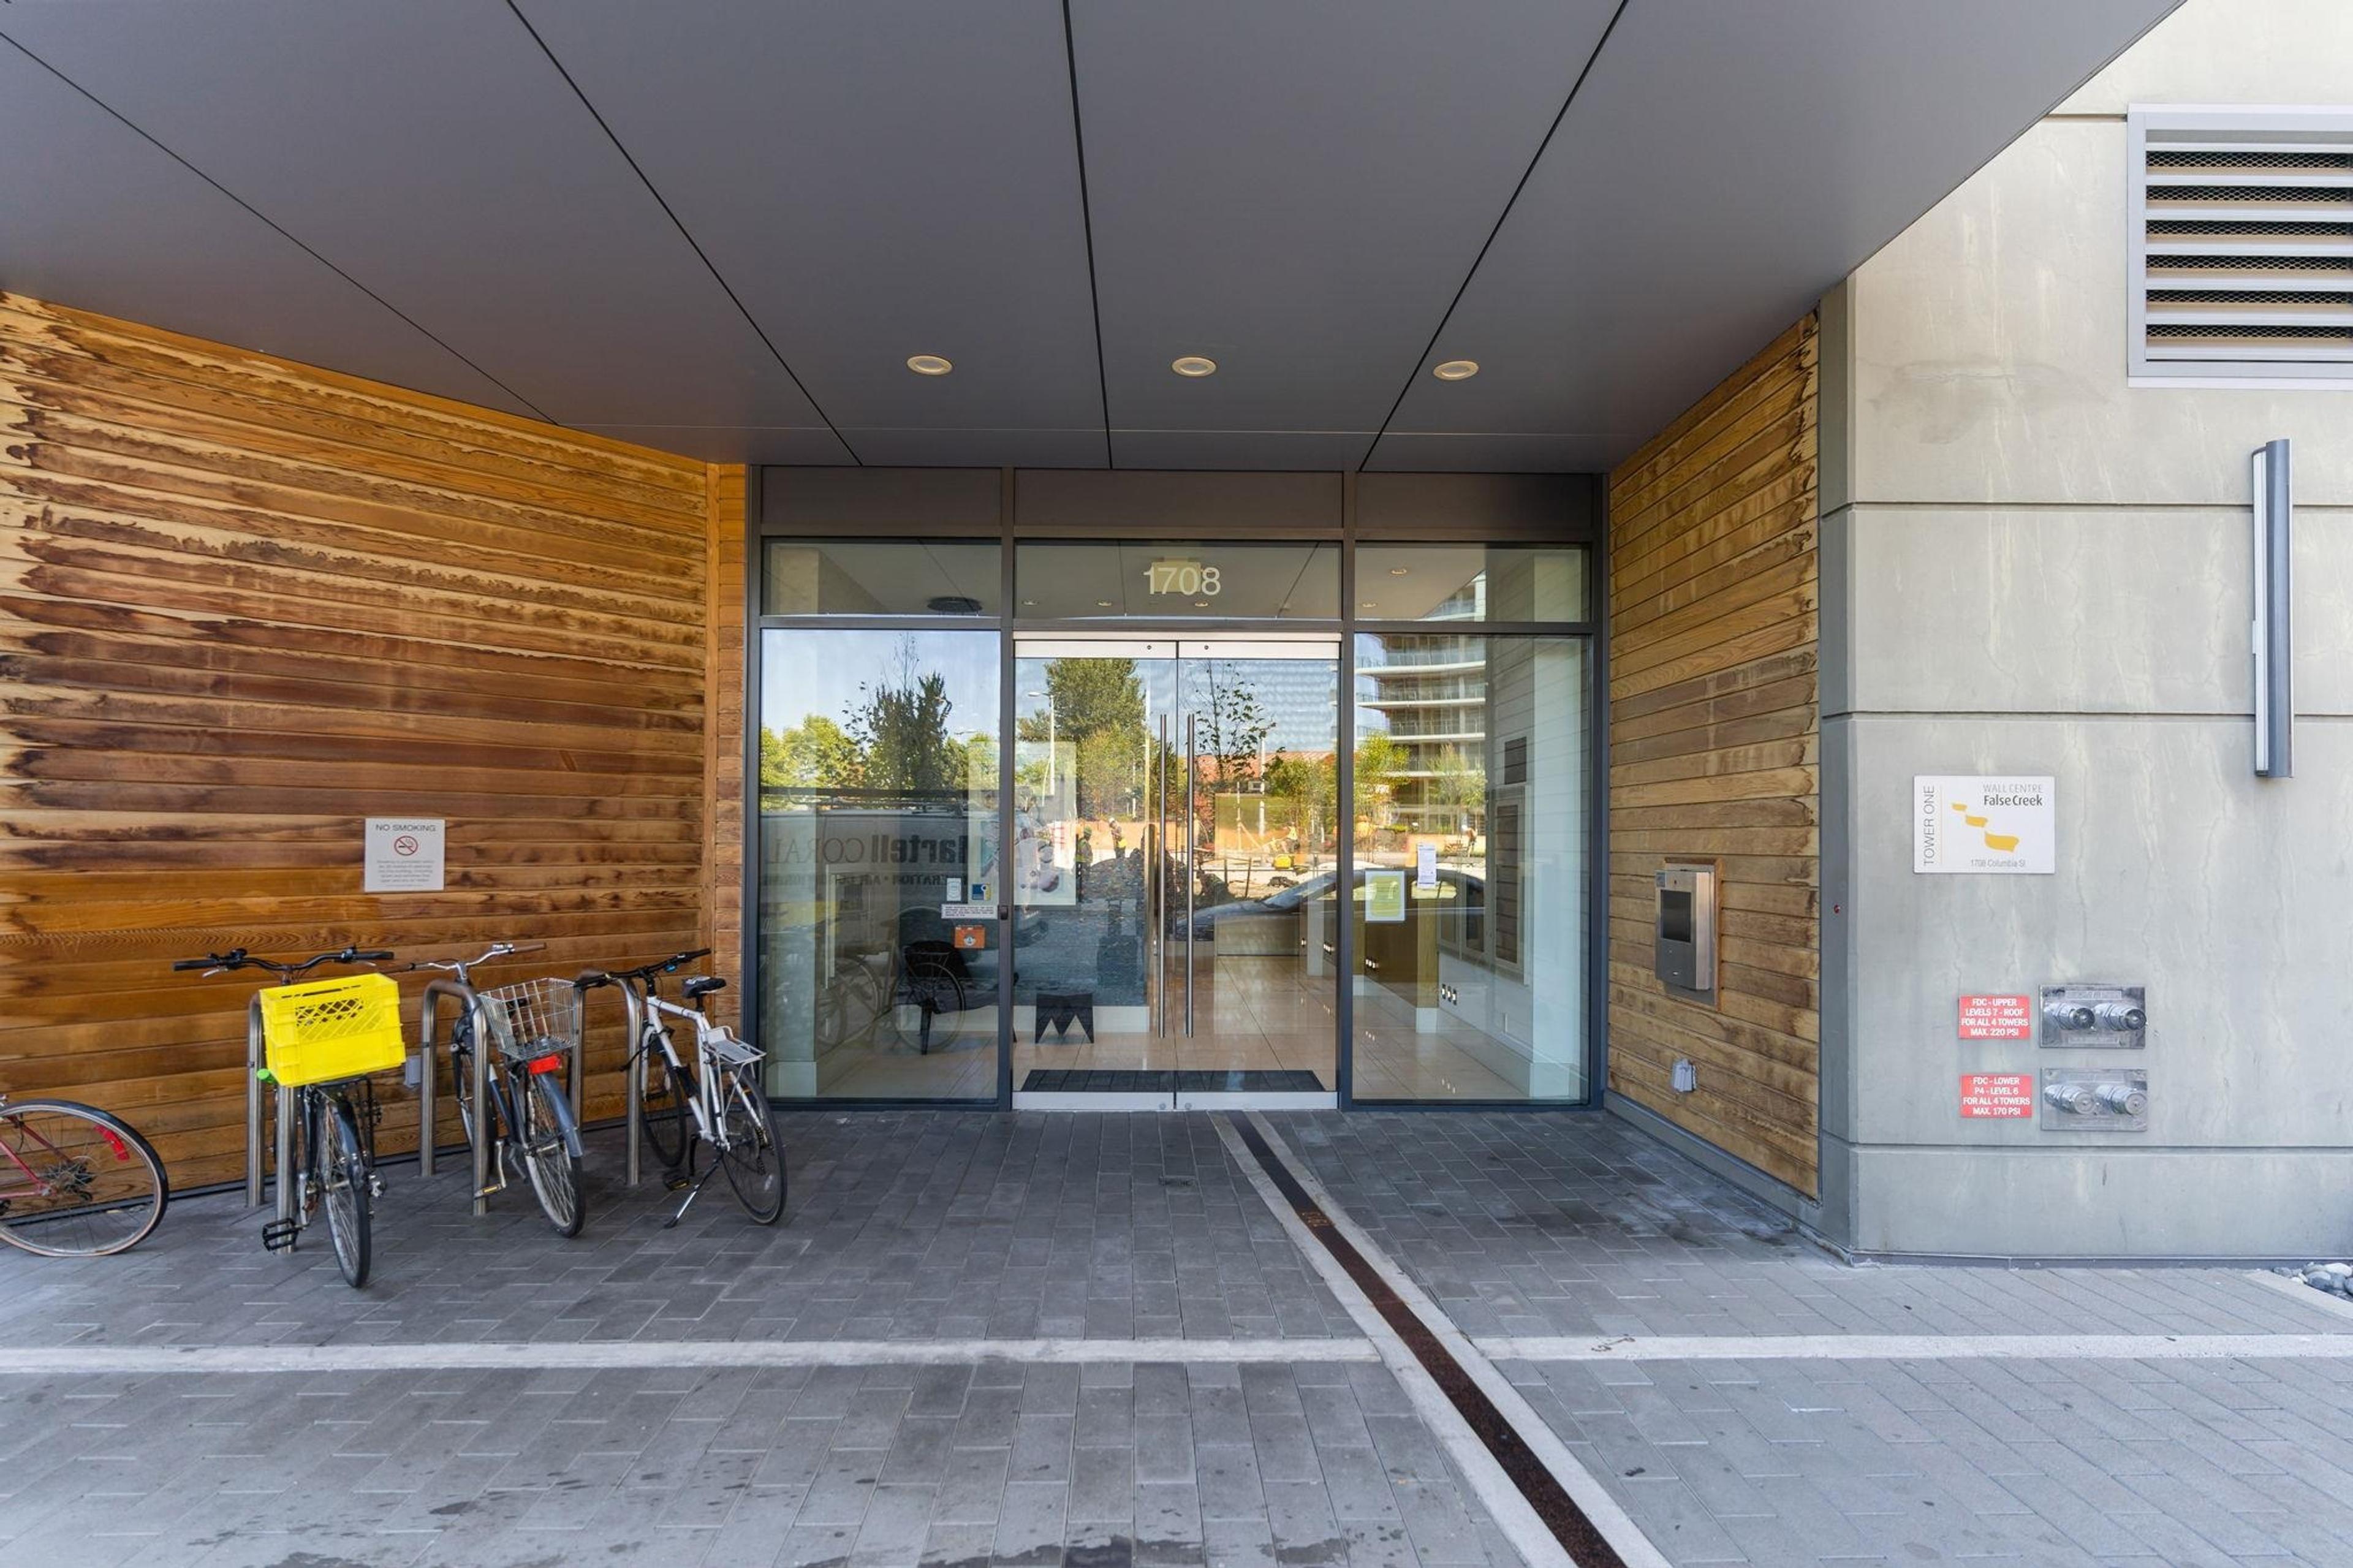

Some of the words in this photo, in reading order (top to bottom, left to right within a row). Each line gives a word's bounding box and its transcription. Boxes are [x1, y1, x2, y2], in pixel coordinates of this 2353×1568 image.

[1143, 567, 1221, 595] 1708
[1984, 784, 2007, 792] WALL
[2009, 784, 2043, 792] CENTRE
[1923, 786, 1934, 814] ONE
[1984, 794, 2011, 806] False
[2012, 794, 2042, 806] Creek
[1923, 819, 1934, 865] TOWER
[1998, 1018, 2029, 1026] TOWERS
[2007, 1107, 2021, 1115] PSI
